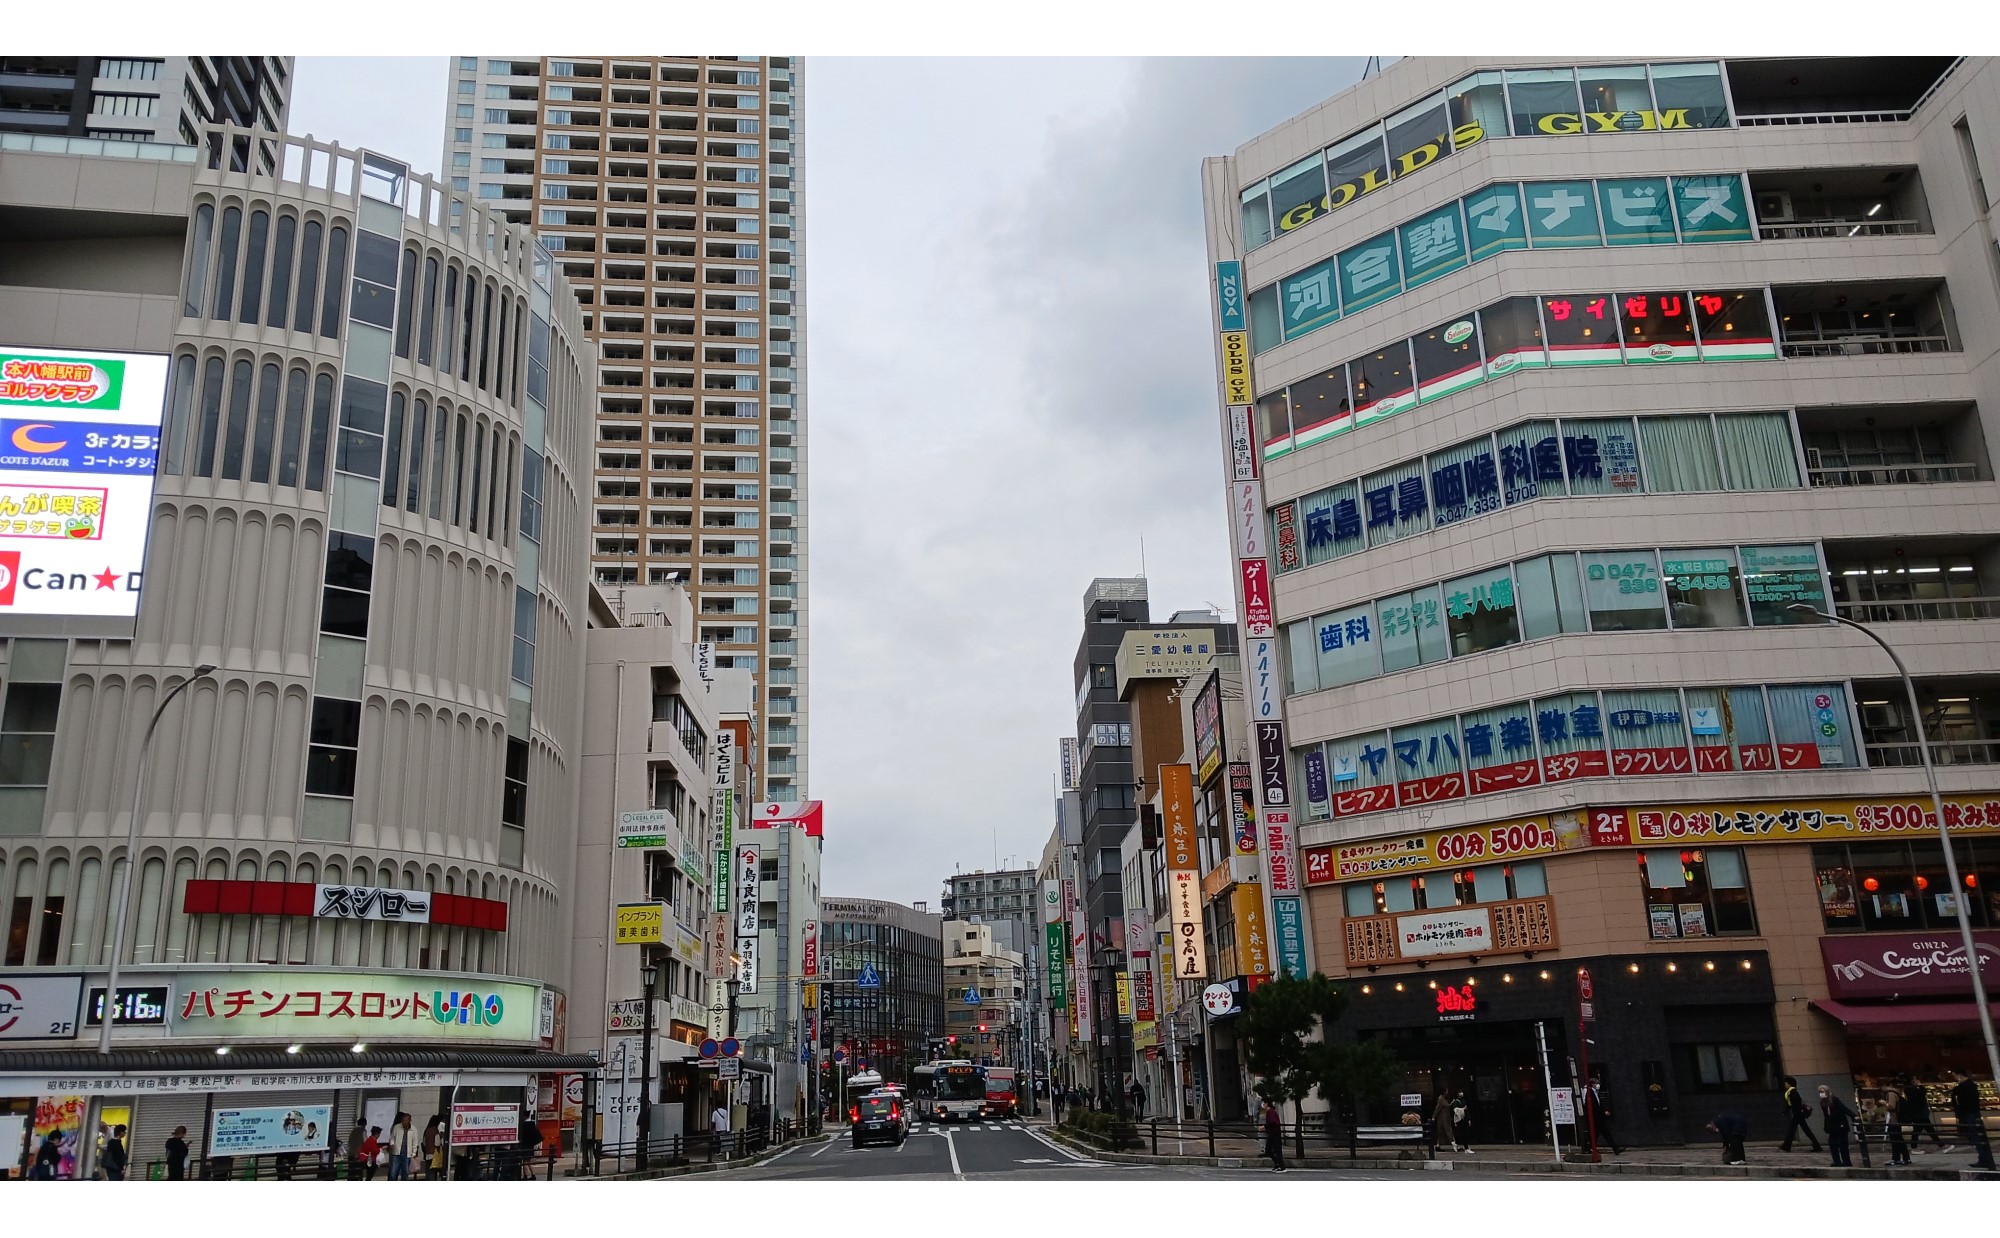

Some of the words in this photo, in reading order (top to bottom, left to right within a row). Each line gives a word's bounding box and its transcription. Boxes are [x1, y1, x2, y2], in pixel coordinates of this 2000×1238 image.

[1538, 109, 1694, 134] GYM
[1280, 120, 1485, 231] GOLD'S
[1289, 186, 1738, 320] 河合塾マナビス
[1222, 275, 1239, 317] NOVA
[1550, 294, 1722, 321] サイゼリヤ
[1227, 334, 1245, 375] GOLD'S
[5, 361, 93, 381] 本八幡駅前
[0, 382, 98, 401] ゴルフクラブ
[1230, 378, 1247, 403] GYM
[85, 433, 109, 448] 3F
[0, 456, 28, 465] COTE
[31, 456, 69, 466] D'AZUR
[1238, 467, 1250, 476] 6F
[1305, 435, 1603, 548] 床島耳鼻咽喉科医院
[1446, 484, 1538, 524] 047-333-9700
[1241, 484, 1255, 555] PATIO
[1275, 504, 1299, 570] 耳鼻科
[23, 568, 87, 590] Can
[1246, 562, 1264, 606] ゲーム
[1619, 579, 1658, 594] 336
[1447, 578, 1514, 619] 本八幡
[1382, 599, 1439, 622] デンタル
[1253, 625, 1266, 634] 5F
[1320, 616, 1371, 654] 歯科
[1384, 615, 1439, 638] オフィス
[1136, 644, 1208, 655] 三愛幼稚園
[1255, 642, 1271, 717] PATIO
[1360, 704, 1603, 777] ヤマハ音楽教室
[1262, 724, 1283, 785] カーブス
[1230, 765, 1251, 776] SHOT
[1337, 788, 1390, 815] ピアノ
[1403, 765, 1535, 804] エレクトーン
[1547, 757, 1604, 779] ギター
[1615, 753, 1688, 773] ウクレレ
[1699, 747, 1803, 770] バイオリン
[1232, 778, 1252, 789] BAR
[1269, 790, 1282, 800] 4F
[1232, 792, 1244, 812] LOTUS
[714, 790, 724, 849] 市川法律事務所
[1234, 813, 1246, 834] EAGLE
[1271, 813, 1284, 823] 2F
[1596, 813, 1624, 833] 2F
[1640, 814, 1664, 836] 元祖
[1668, 810, 1848, 838] 0秒レモンサワー
[1241, 839, 1254, 849] 3F
[1340, 838, 1425, 859] 全卓サワータワー完備
[1436, 832, 1486, 861] 60分
[1490, 823, 1556, 854] 500円
[1308, 853, 1330, 871] 2F
[719, 853, 728, 911] たかはし歯科医院
[319, 887, 428, 917] スシロー
[1180, 882, 1191, 918] 中華食堂
[1280, 901, 1294, 912] 7F
[619, 911, 660, 922] インプラント
[618, 926, 660, 938] 審美歯科
[1415, 926, 1483, 942] ホルモン焼肉酒場
[806, 944, 814, 967] アコム
[1180, 922, 1200, 976] 日高屋
[1912, 941, 1949, 950] GINZA
[1050, 937, 1063, 997] りそな銀行
[1883, 951, 1932, 974] Cozy
[1077, 958, 1088, 1020] SMBC日興証券
[1135, 972, 1149, 1011] 接骨院
[1205, 991, 1231, 1000] タンメン
[181, 987, 430, 1019] パチンコスロット
[611, 1002, 645, 1015] 本八幡
[823, 990, 831, 1012] KFC
[50, 1022, 72, 1034] 2F
[136, 1079, 155, 1089] 経由
[157, 1075, 235, 1087] 高塚・東松戸駅
[336, 1075, 351, 1084] 経由
[352, 1072, 436, 1082] 大町駅・市川営業所
